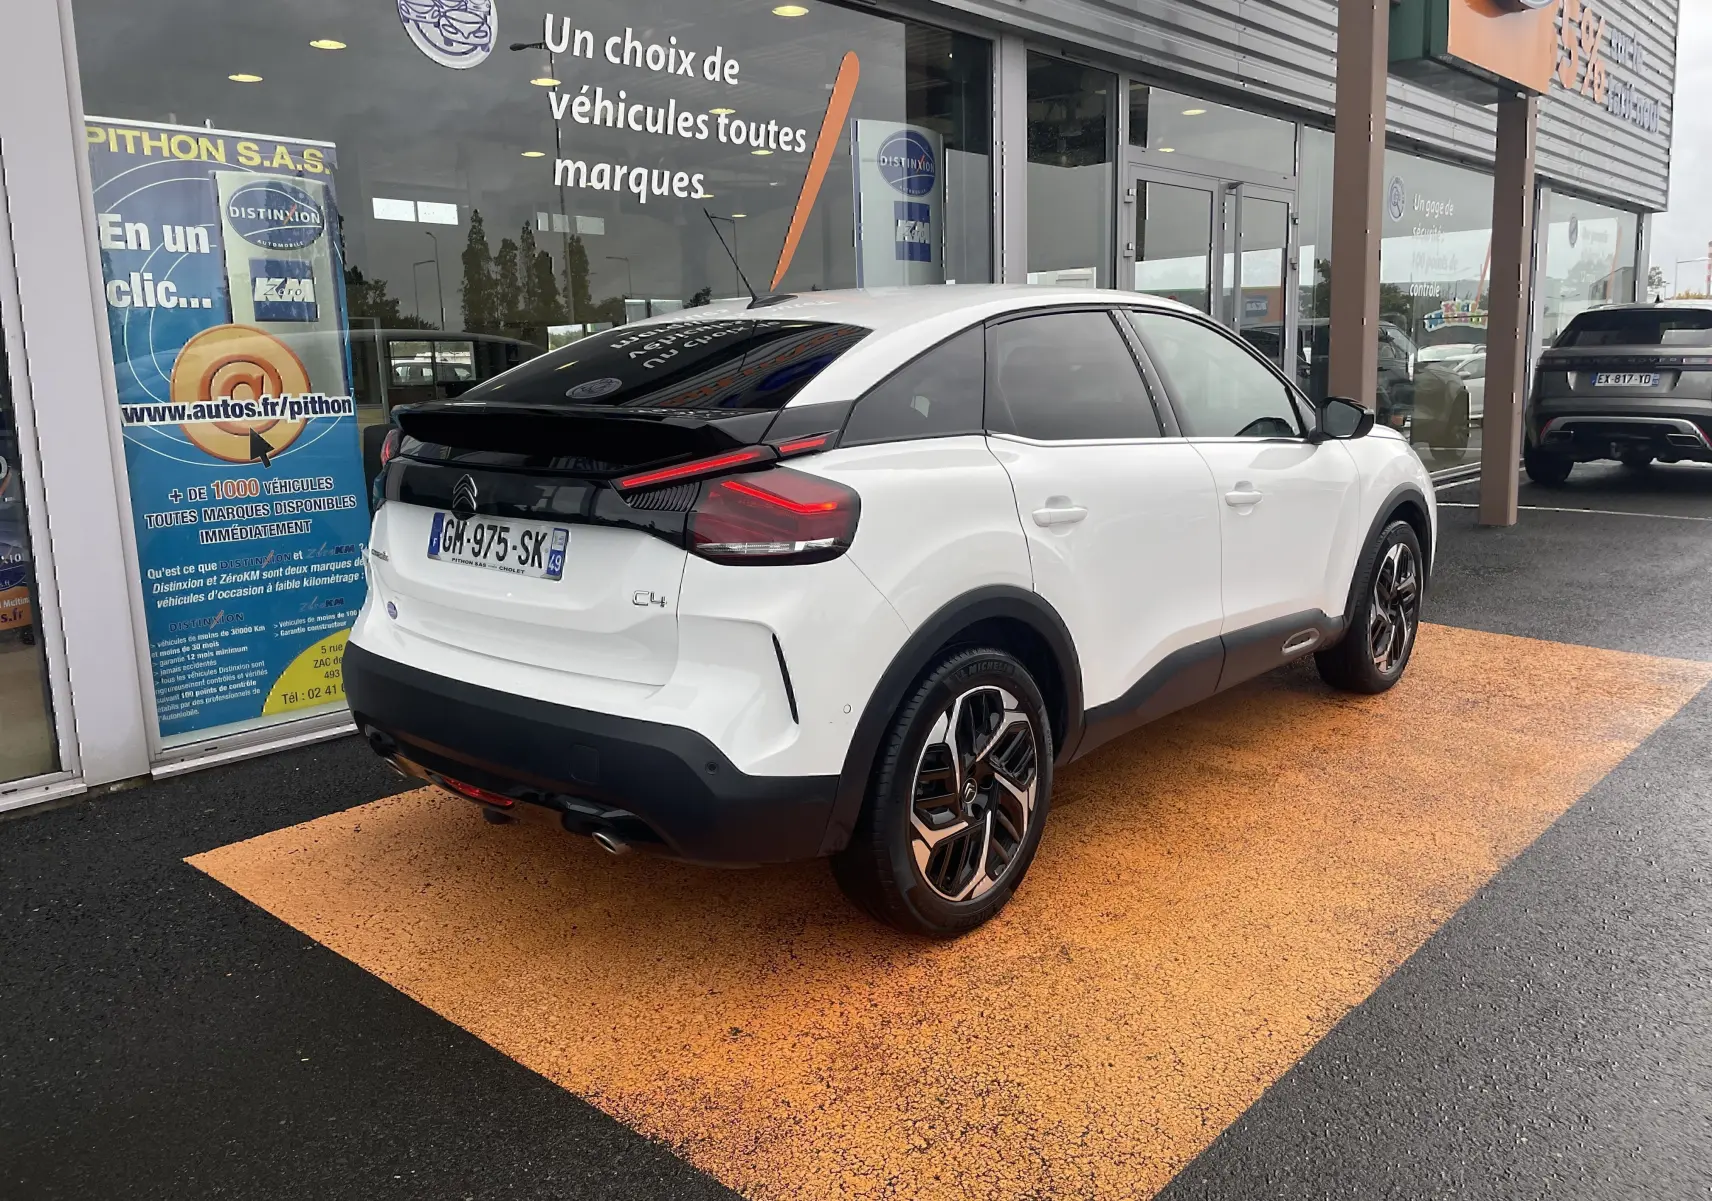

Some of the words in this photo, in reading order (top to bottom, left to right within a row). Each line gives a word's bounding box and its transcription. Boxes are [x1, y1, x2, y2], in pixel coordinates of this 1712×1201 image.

[544, 12, 594, 59] Un
[605, 26, 696, 78] choix
[702, 45, 740, 86] de
[547, 84, 709, 140] véhicules
[717, 112, 807, 153] toutes
[84, 126, 226, 162] PITHON
[236, 142, 332, 175] S.A.S.
[879, 153, 935, 174] DISTINXION
[554, 157, 706, 204] marques
[229, 203, 320, 225] DISTINXION
[1413, 193, 1425, 211] Un
[1425, 199, 1444, 219] gage
[1444, 199, 1454, 216] de
[97, 213, 151, 251] En
[162, 223, 210, 254] un
[257, 239, 304, 249] AUTOMOBILE
[106, 272, 212, 309] clic...
[1597, 373, 1651, 384] EX-817-YD
[122, 394, 354, 424] www.autos.fr/pithon
[187, 486, 208, 502] DE
[211, 478, 260, 500] 1000
[263, 476, 334, 496] VÉHICULES
[144, 510, 198, 529] TOUTES
[202, 503, 271, 523] MARQUES
[274, 495, 357, 515] DISPONIBLES
[199, 519, 312, 545] IMMÉDIATEMENT
[442, 518, 548, 569] GM-975-SK
[147, 564, 181, 580] Qu'est
[183, 564, 196, 574] ce
[198, 561, 218, 573] que
[220, 550, 291, 570] DISTINXION
[293, 550, 303, 560] et
[451, 557, 474, 567] PITHON
[499, 566, 525, 574] CHOLET
[548, 554, 563, 572] 49
[152, 578, 204, 594] Distinxion
[206, 575, 217, 586] et
[219, 569, 260, 585] ZéroKM
[262, 567, 284, 580] sont
[285, 564, 308, 577] deux
[310, 560, 352, 573] marques
[156, 591, 205, 609] véhicules
[208, 583, 264, 601] d'occasion
[266, 582, 273, 593] à
[275, 578, 301, 592] faible
[632, 589, 667, 608] C4
[321, 645, 327, 654] 5
[329, 643, 343, 653] rue
[313, 658, 331, 669] ZAC
[968, 661, 1015, 676] MICHELIN
[281, 691, 298, 705] Tél
[307, 687, 322, 700] 02
[325, 684, 337, 695] 41
